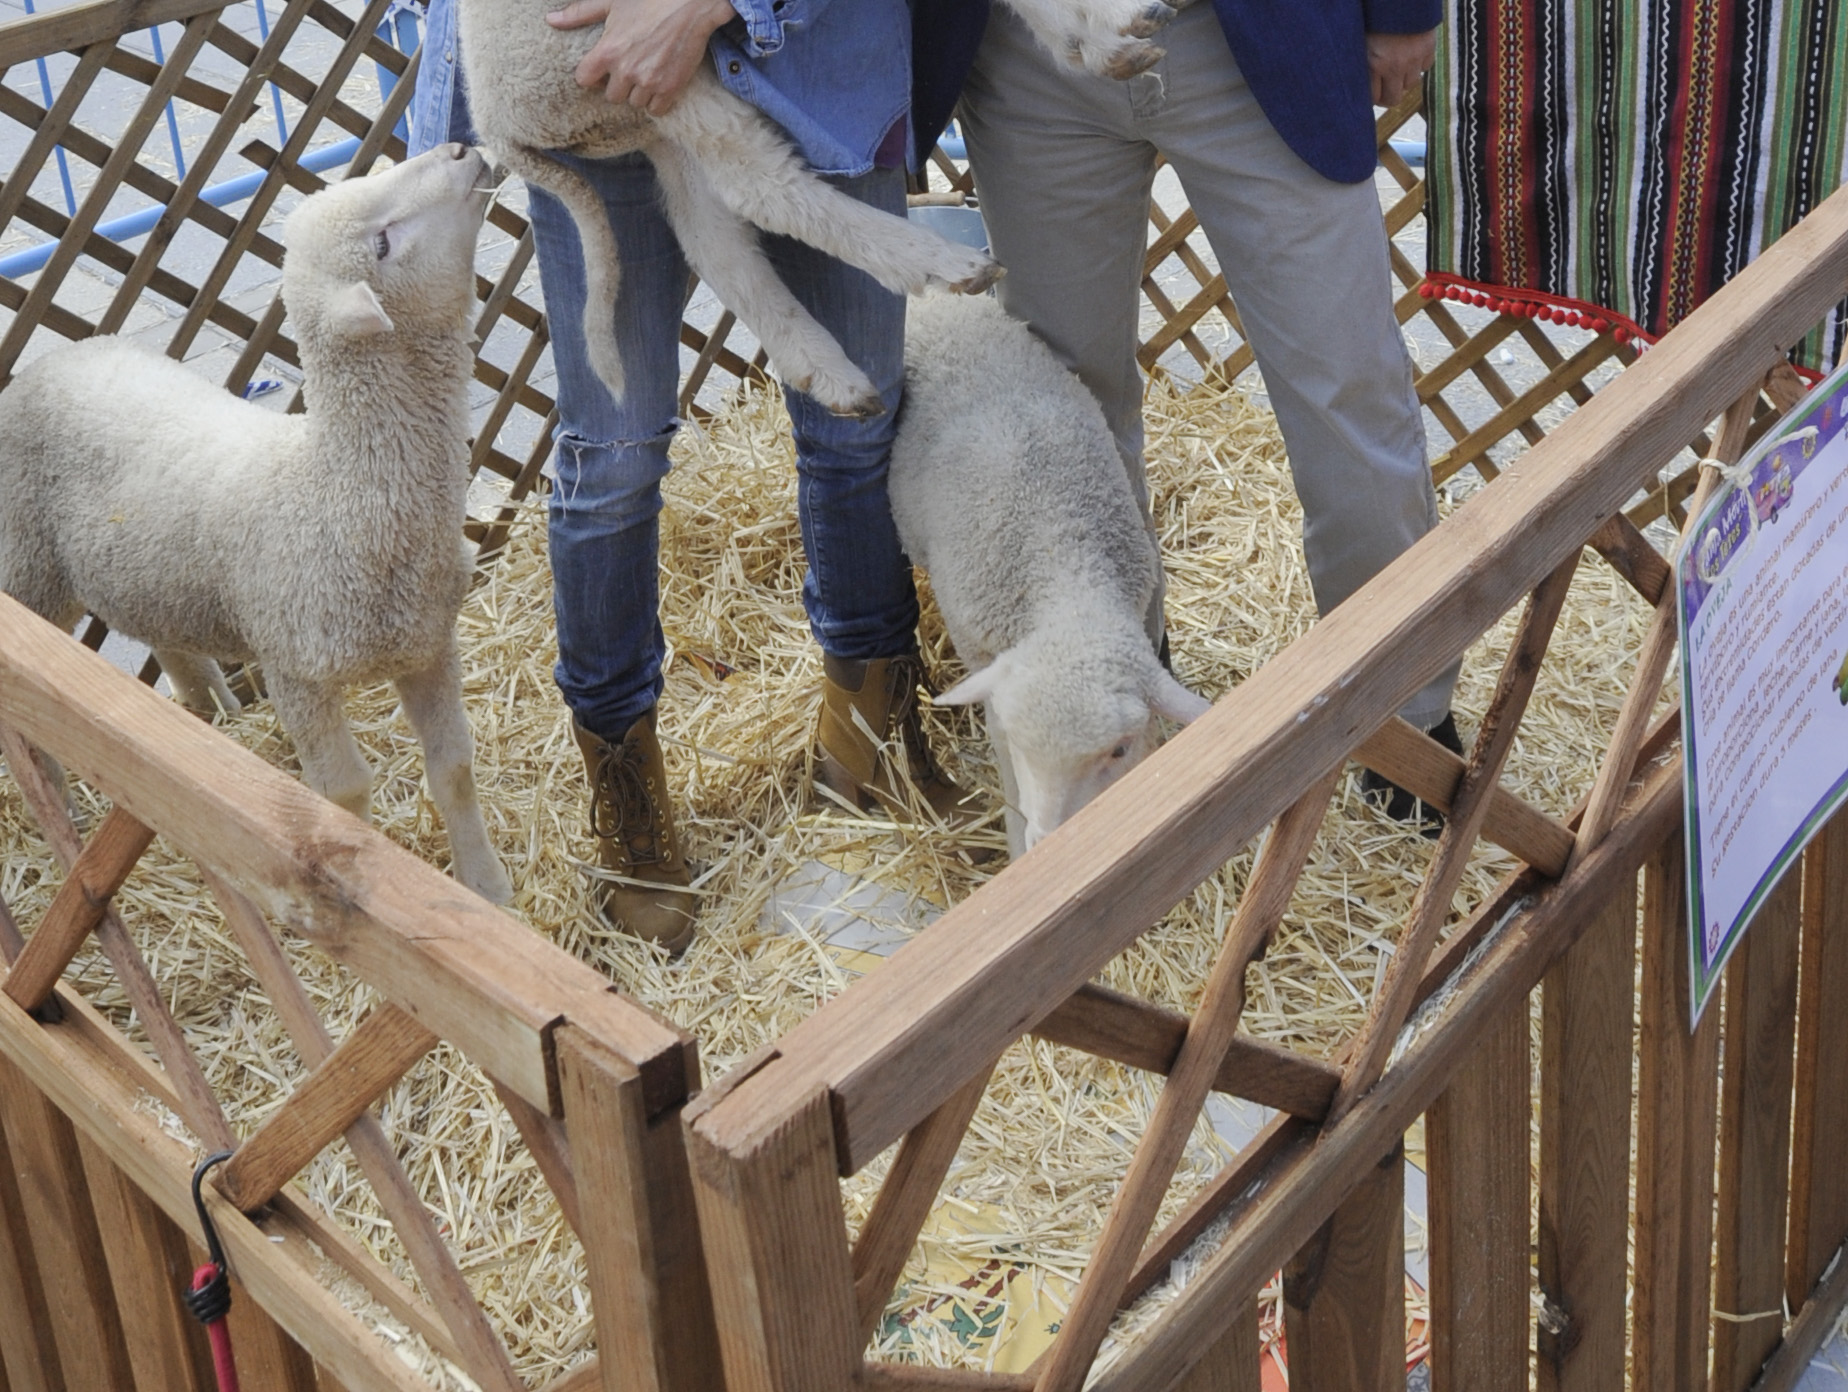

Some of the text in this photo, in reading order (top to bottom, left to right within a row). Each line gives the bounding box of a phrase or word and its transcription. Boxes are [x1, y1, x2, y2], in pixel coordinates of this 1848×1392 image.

[1695, 577, 1732, 654] LA OVEJA
[1699, 655, 1707, 681] La
[1709, 621, 1727, 658] oveja
[1729, 604, 1737, 625] es
[1739, 583, 1753, 609] una
[1756, 544, 1781, 586] animal
[1823, 488, 1829, 503] y
[1715, 607, 1765, 692] extremidades
[1791, 534, 1824, 581] dotadas
[1826, 520, 1837, 538] de
[1735, 621, 1740, 638] y
[1706, 740, 1721, 778] Este
[1724, 698, 1746, 744] animal
[1748, 683, 1756, 702] es
[1758, 658, 1774, 688] muy
[1776, 597, 1821, 663] importante
[1823, 576, 1841, 604] para
[1709, 779, 1723, 816] para
[1778, 650, 1810, 702] prendas
[1812, 635, 1822, 655] de
[1710, 649, 1838, 849] Tiene el cuerpo cubierto de lana
[1715, 700, 1759, 781] proporciona
[1815, 618, 1820, 633] y
[1718, 689, 1725, 710] se
[1727, 658, 1745, 694] llama
[1711, 852, 1721, 881] Su
[1760, 755, 1779, 789] dura
